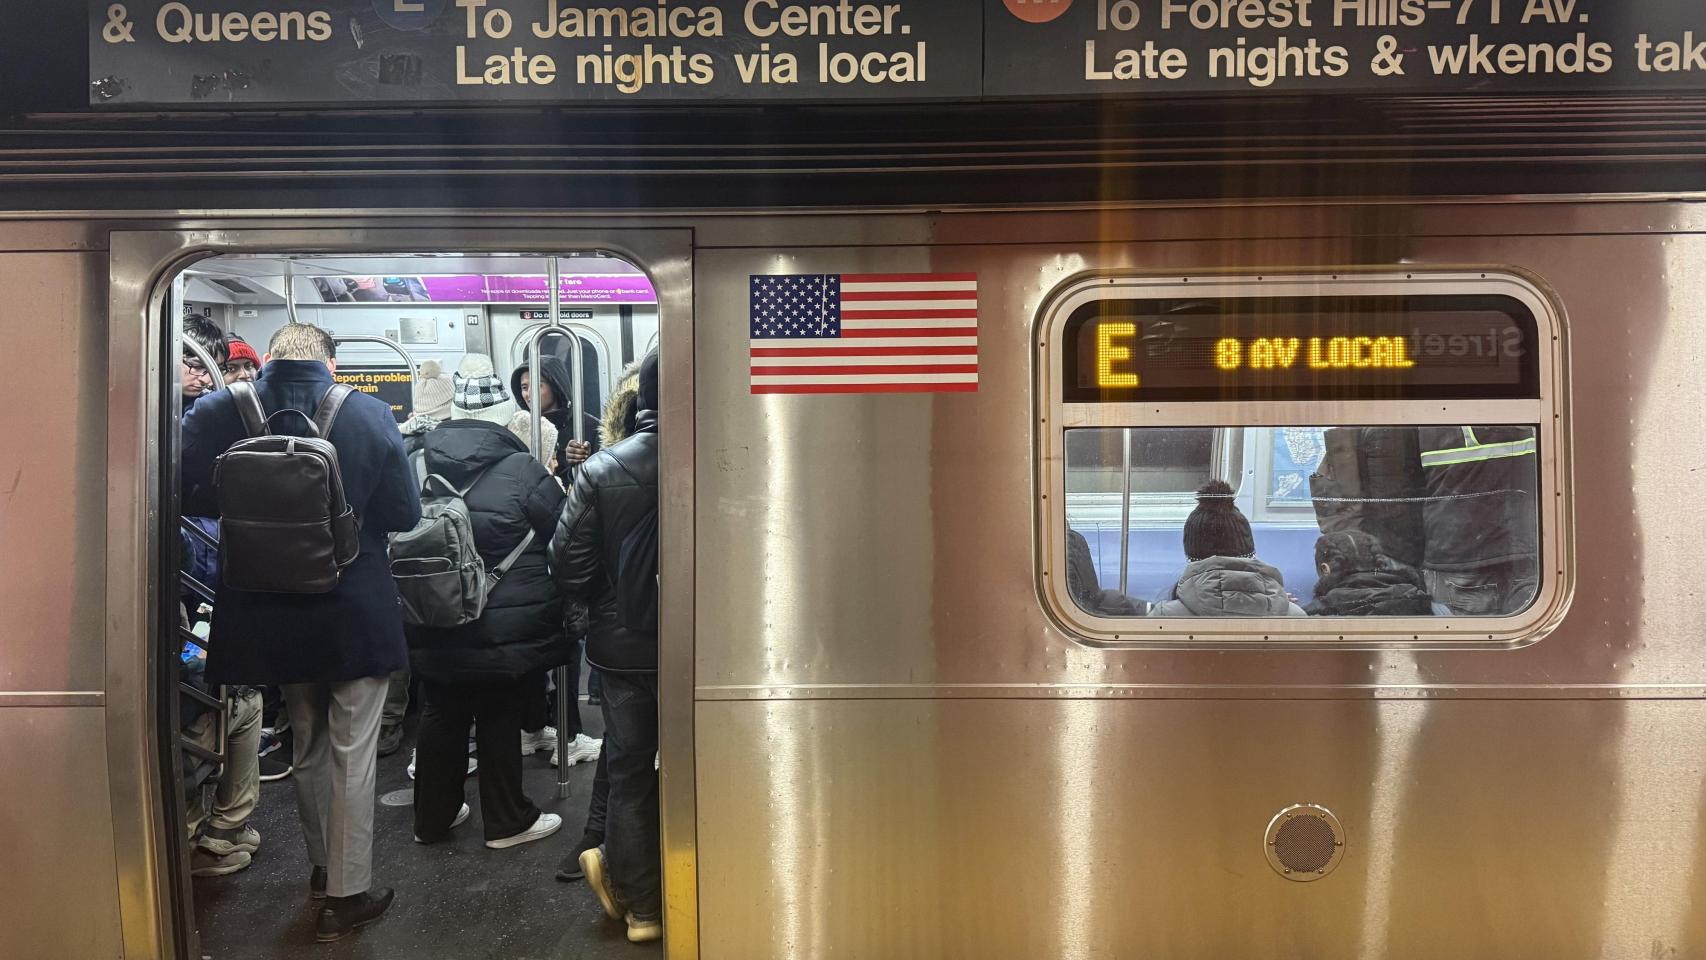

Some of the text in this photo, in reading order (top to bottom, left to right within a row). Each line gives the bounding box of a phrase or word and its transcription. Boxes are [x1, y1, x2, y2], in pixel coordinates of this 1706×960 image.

[102, 2, 332, 43] & Queens
[456, 0, 911, 38] To Jamaica Center.
[1161, 0, 1312, 29] Forest
[1520, 0, 1589, 24] Av.
[456, 41, 926, 93] Late nights via local
[1085, 39, 1188, 80] Late
[1208, 37, 1349, 87] nights
[1370, 35, 1405, 76] &
[1428, 32, 1613, 74] wkends
[1098, 323, 1138, 386] E
[1214, 336, 1415, 369] 8 AV LOCAL
